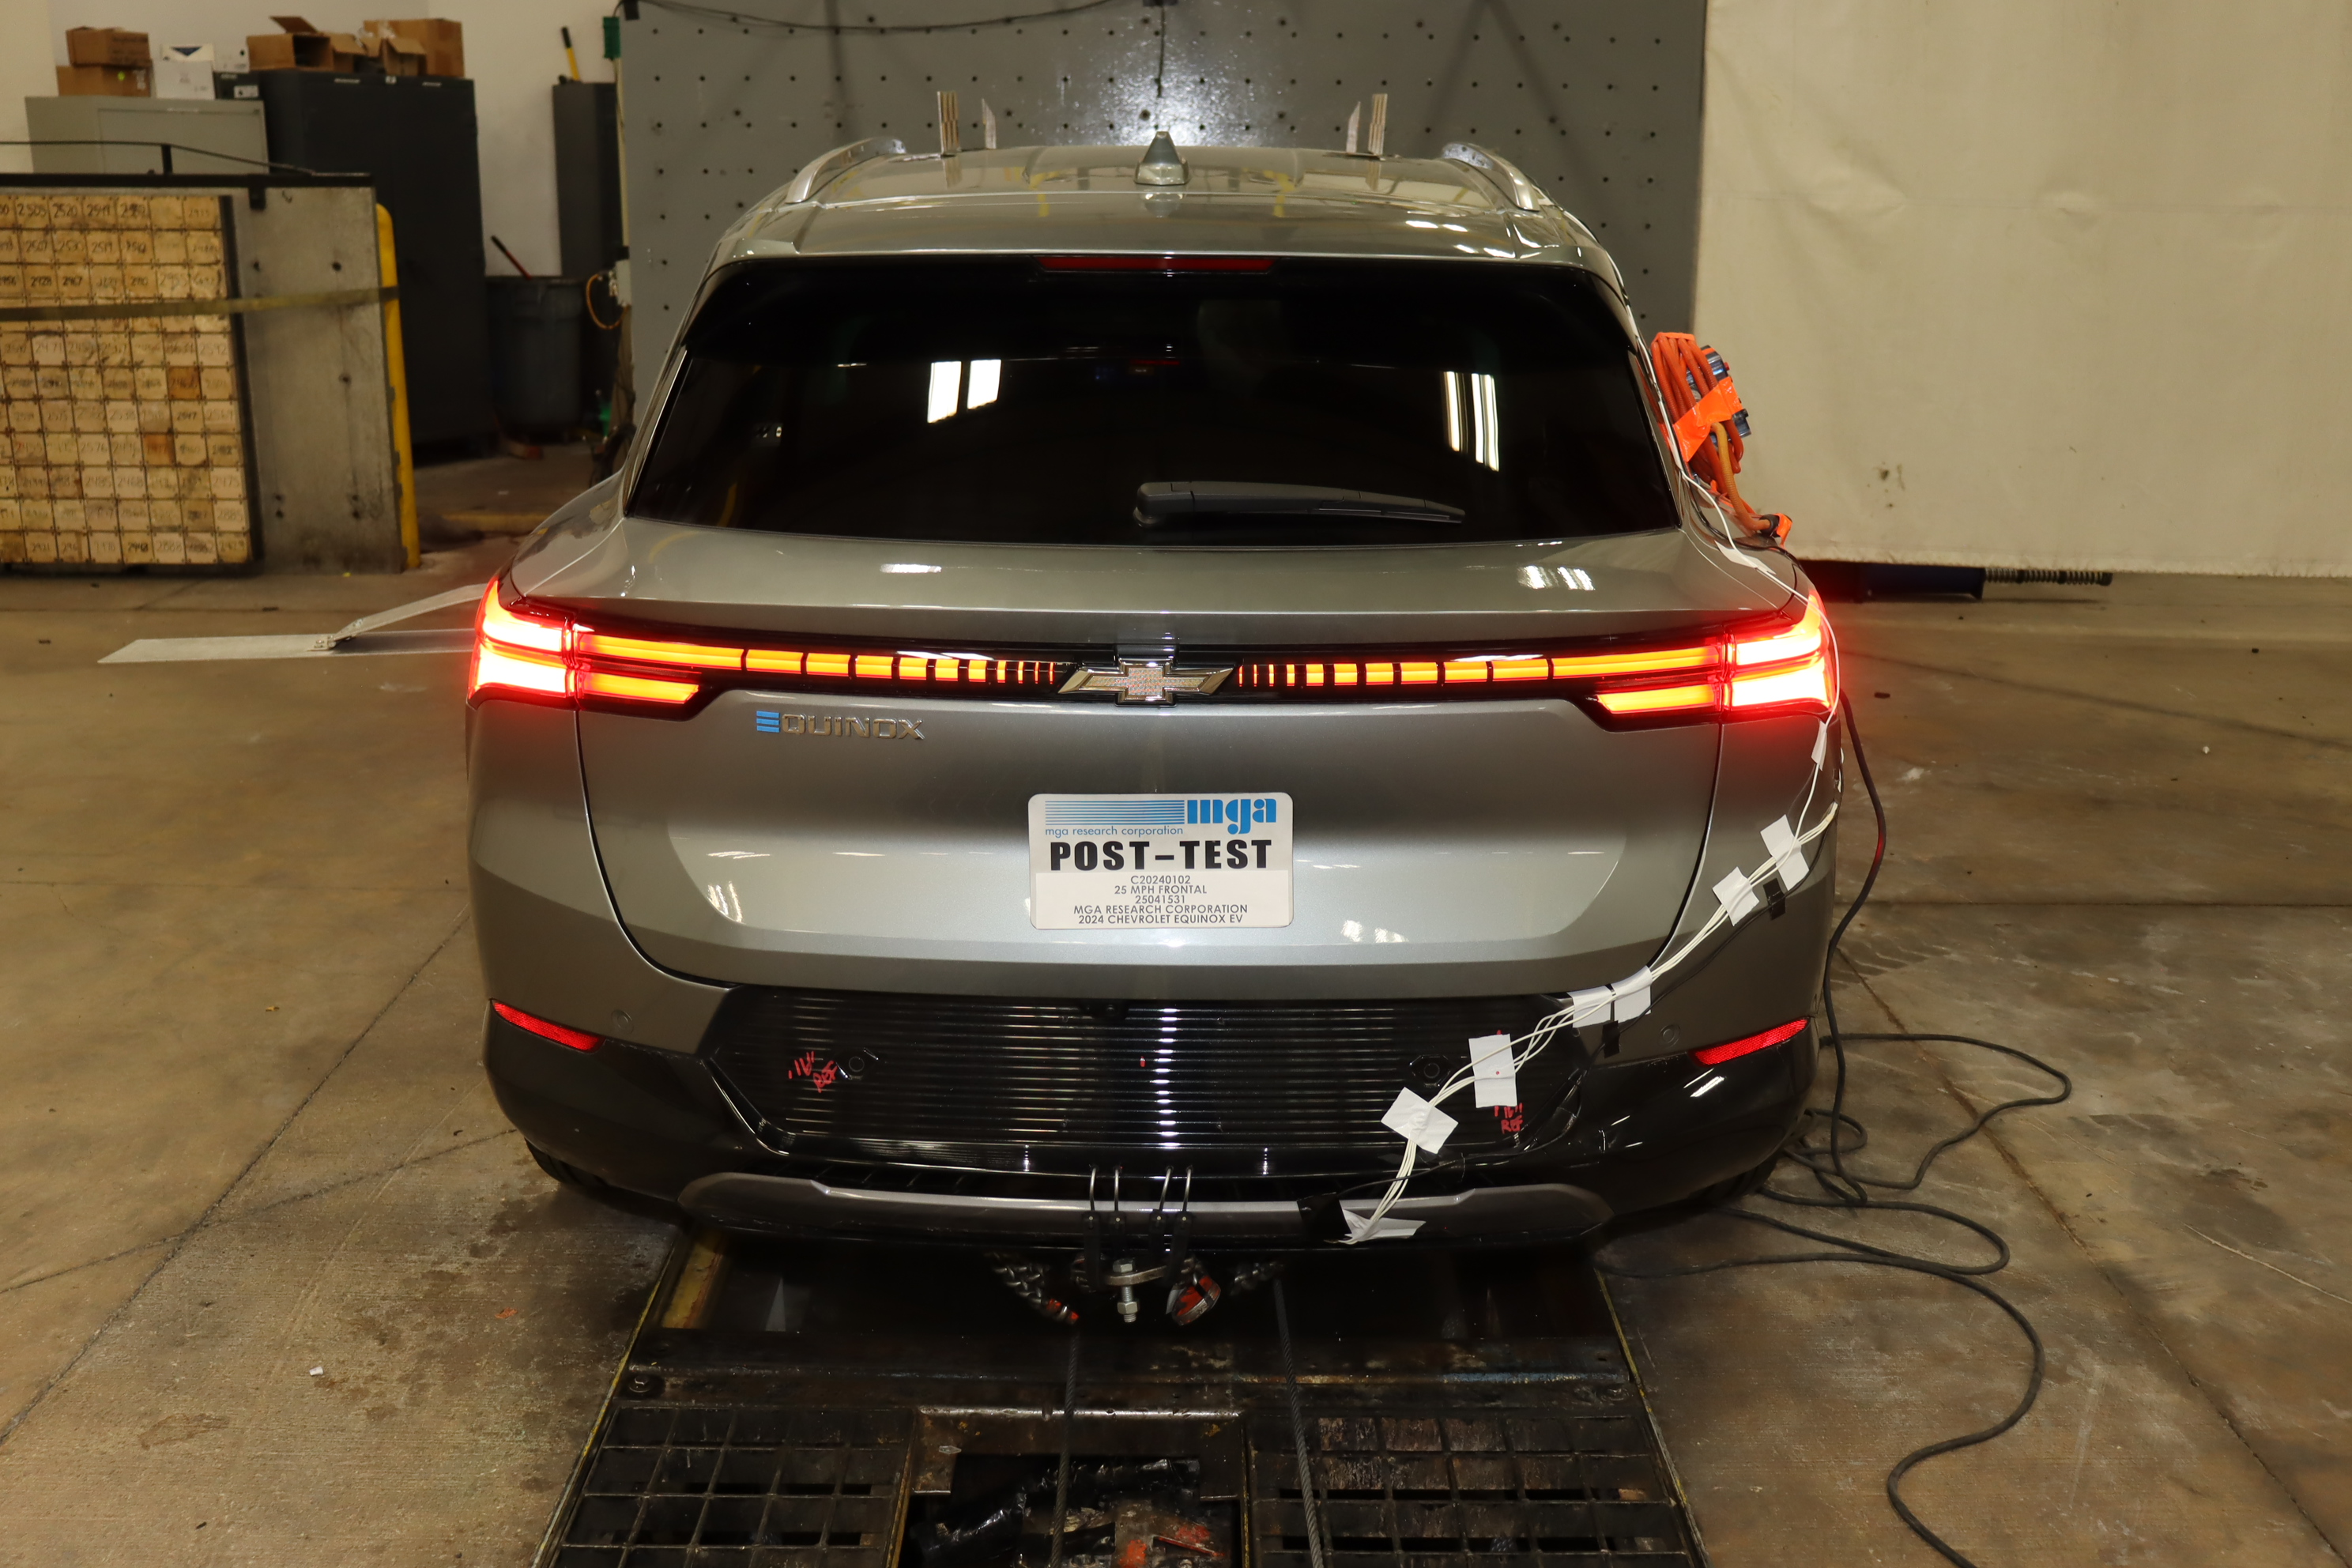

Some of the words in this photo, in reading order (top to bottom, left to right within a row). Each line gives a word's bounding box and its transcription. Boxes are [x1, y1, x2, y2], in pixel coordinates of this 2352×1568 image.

[756, 710, 925, 740] EQUINOX
[1187, 798, 1277, 835] mga
[1045, 827, 1069, 839] mga
[1072, 825, 1118, 835] research
[1121, 825, 1183, 838] corporation
[1050, 839, 1272, 871] POST-TEST
[1130, 875, 1191, 884] C20240102
[1114, 885, 1127, 895] 25
[1130, 885, 1155, 894] MPH
[1159, 884, 1207, 894] FRONTAL
[1135, 895, 1185, 904] 25041531
[1074, 905, 1102, 914] MGA
[1106, 904, 1162, 914] RESEARCH
[1165, 904, 1248, 914] CORPORATION
[1078, 915, 1104, 924] 2024
[1108, 914, 1170, 924] CHEVROLET
[1174, 914, 1226, 925] EQUINOX
[1229, 914, 1243, 923] EV
